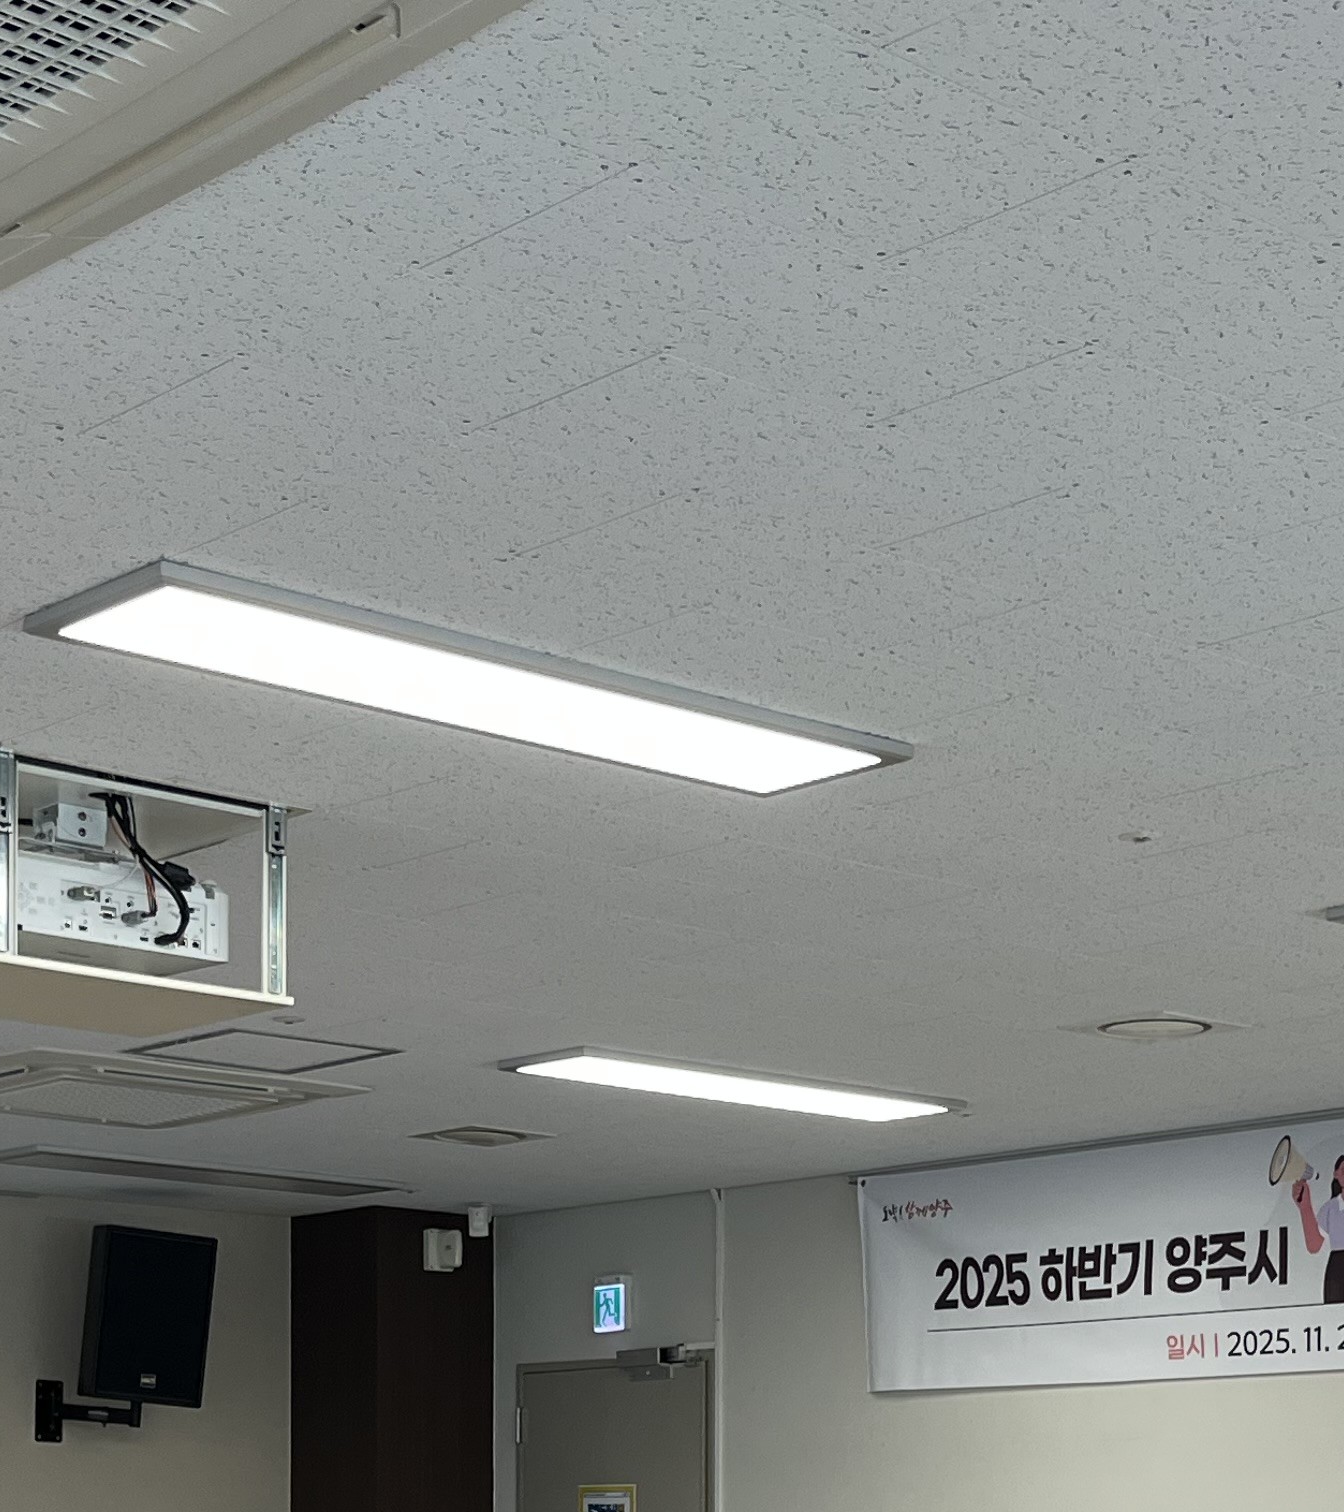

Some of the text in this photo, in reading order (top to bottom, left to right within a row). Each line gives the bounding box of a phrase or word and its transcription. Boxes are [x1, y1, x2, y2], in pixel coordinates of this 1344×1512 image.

[934, 1252, 1031, 1310] 2025
[1039, 1239, 1154, 1302] 하반기
[1165, 1226, 1288, 1294] 양주시
[1166, 1333, 1205, 1360] 일시
[1227, 1328, 1296, 1357] 2025.
[1303, 1326, 1330, 1352] 11.
